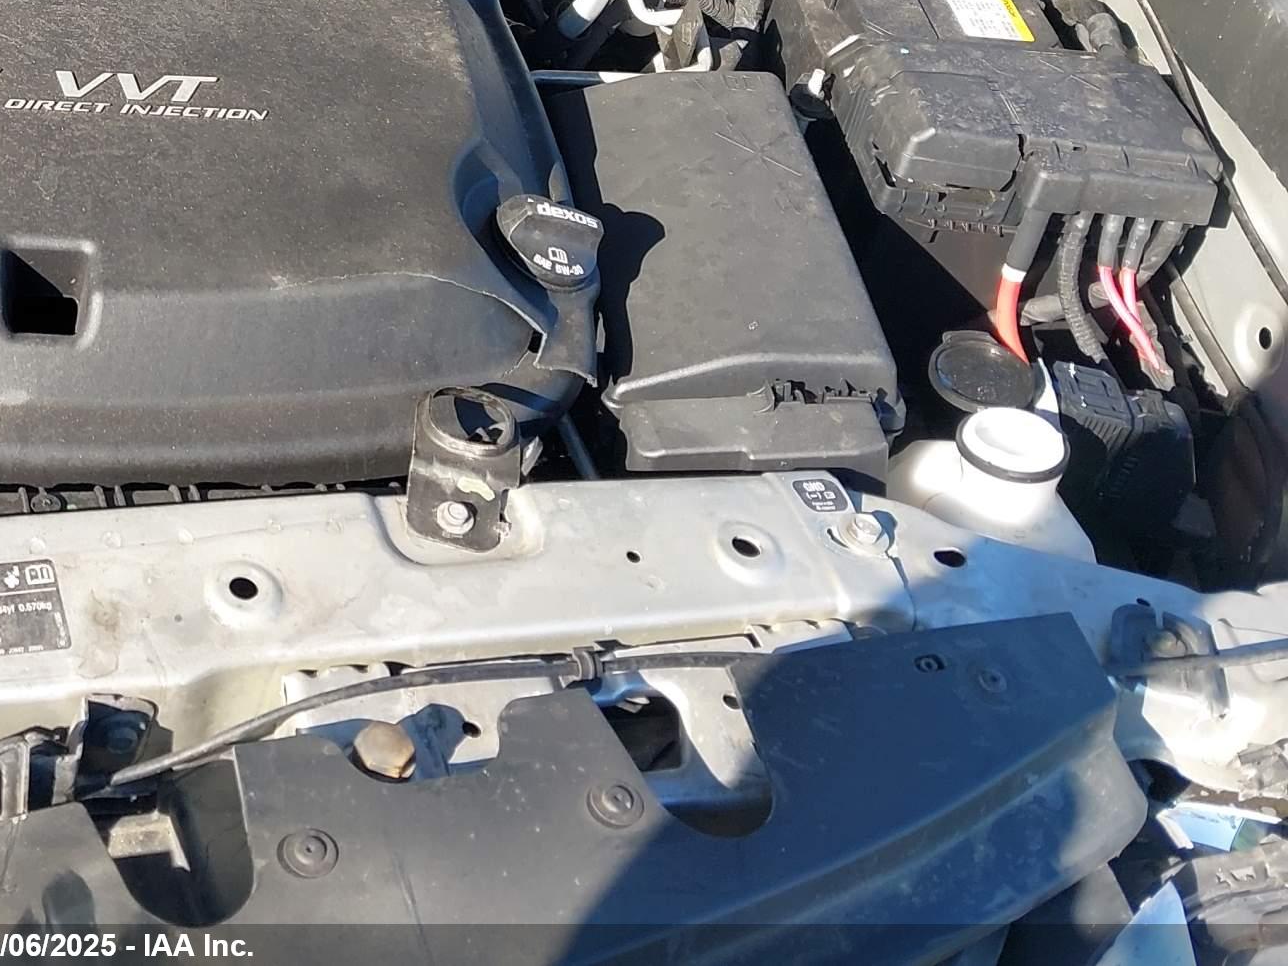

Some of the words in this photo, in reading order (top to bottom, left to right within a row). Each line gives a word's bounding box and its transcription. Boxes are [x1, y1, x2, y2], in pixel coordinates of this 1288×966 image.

[55, 70, 219, 102] VVT
[4, 98, 111, 114] DIRECT
[120, 103, 268, 121] INJECTION
[536, 202, 598, 229] dexos
